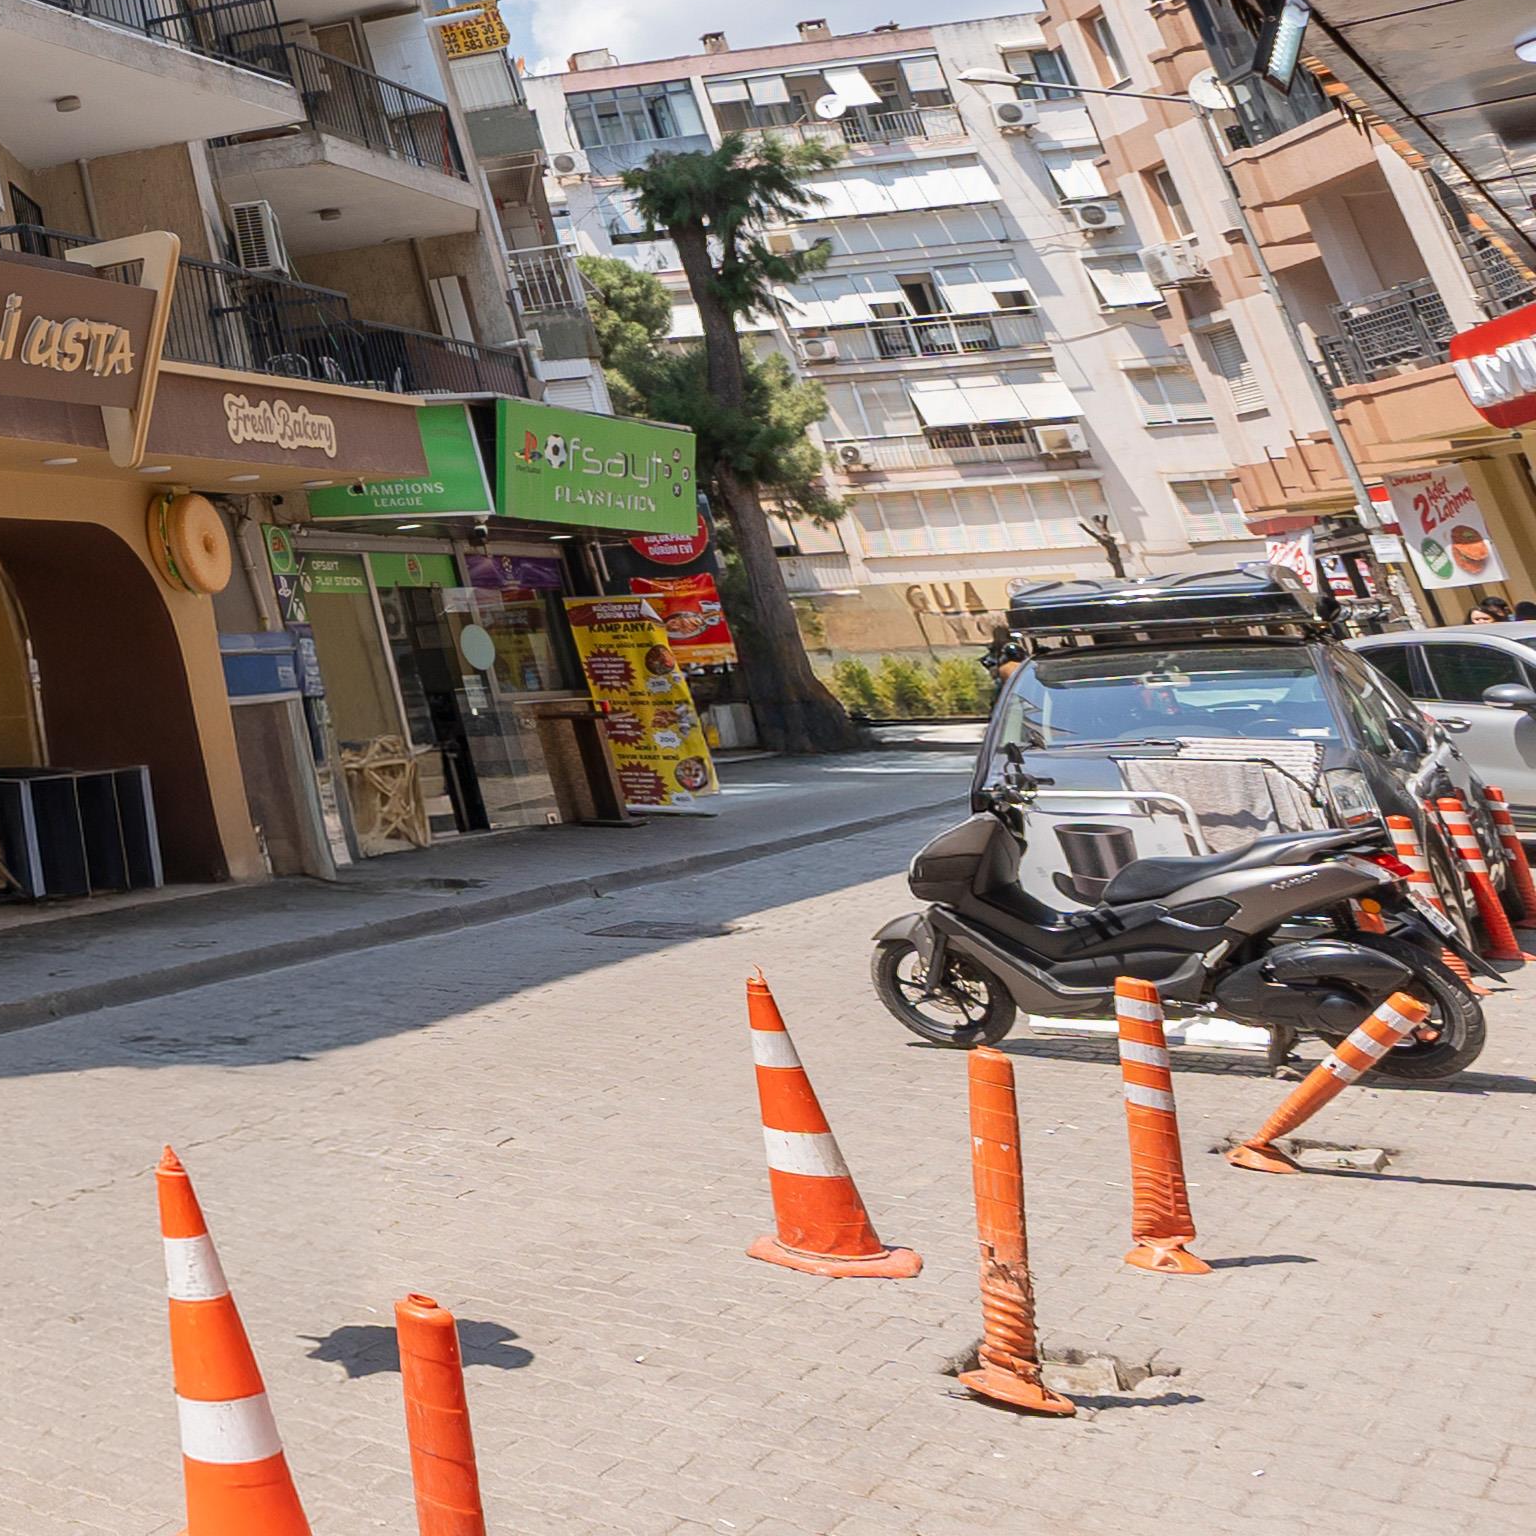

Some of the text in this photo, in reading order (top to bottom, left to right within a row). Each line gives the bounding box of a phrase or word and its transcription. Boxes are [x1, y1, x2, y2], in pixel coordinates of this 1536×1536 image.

[460, 27, 479, 40] 165
[481, 24, 495, 35] 30
[464, 38, 483, 51] 583
[485, 35, 499, 47] 65
[24, 314, 135, 378] USTA
[229, 400, 334, 453] Fresh Bakery
[374, 496, 443, 507] LEAGUE
[554, 485, 657, 512] PLAYSTATION
[1413, 494, 1436, 533] 2
[588, 622, 655, 633] KAMPANYA
